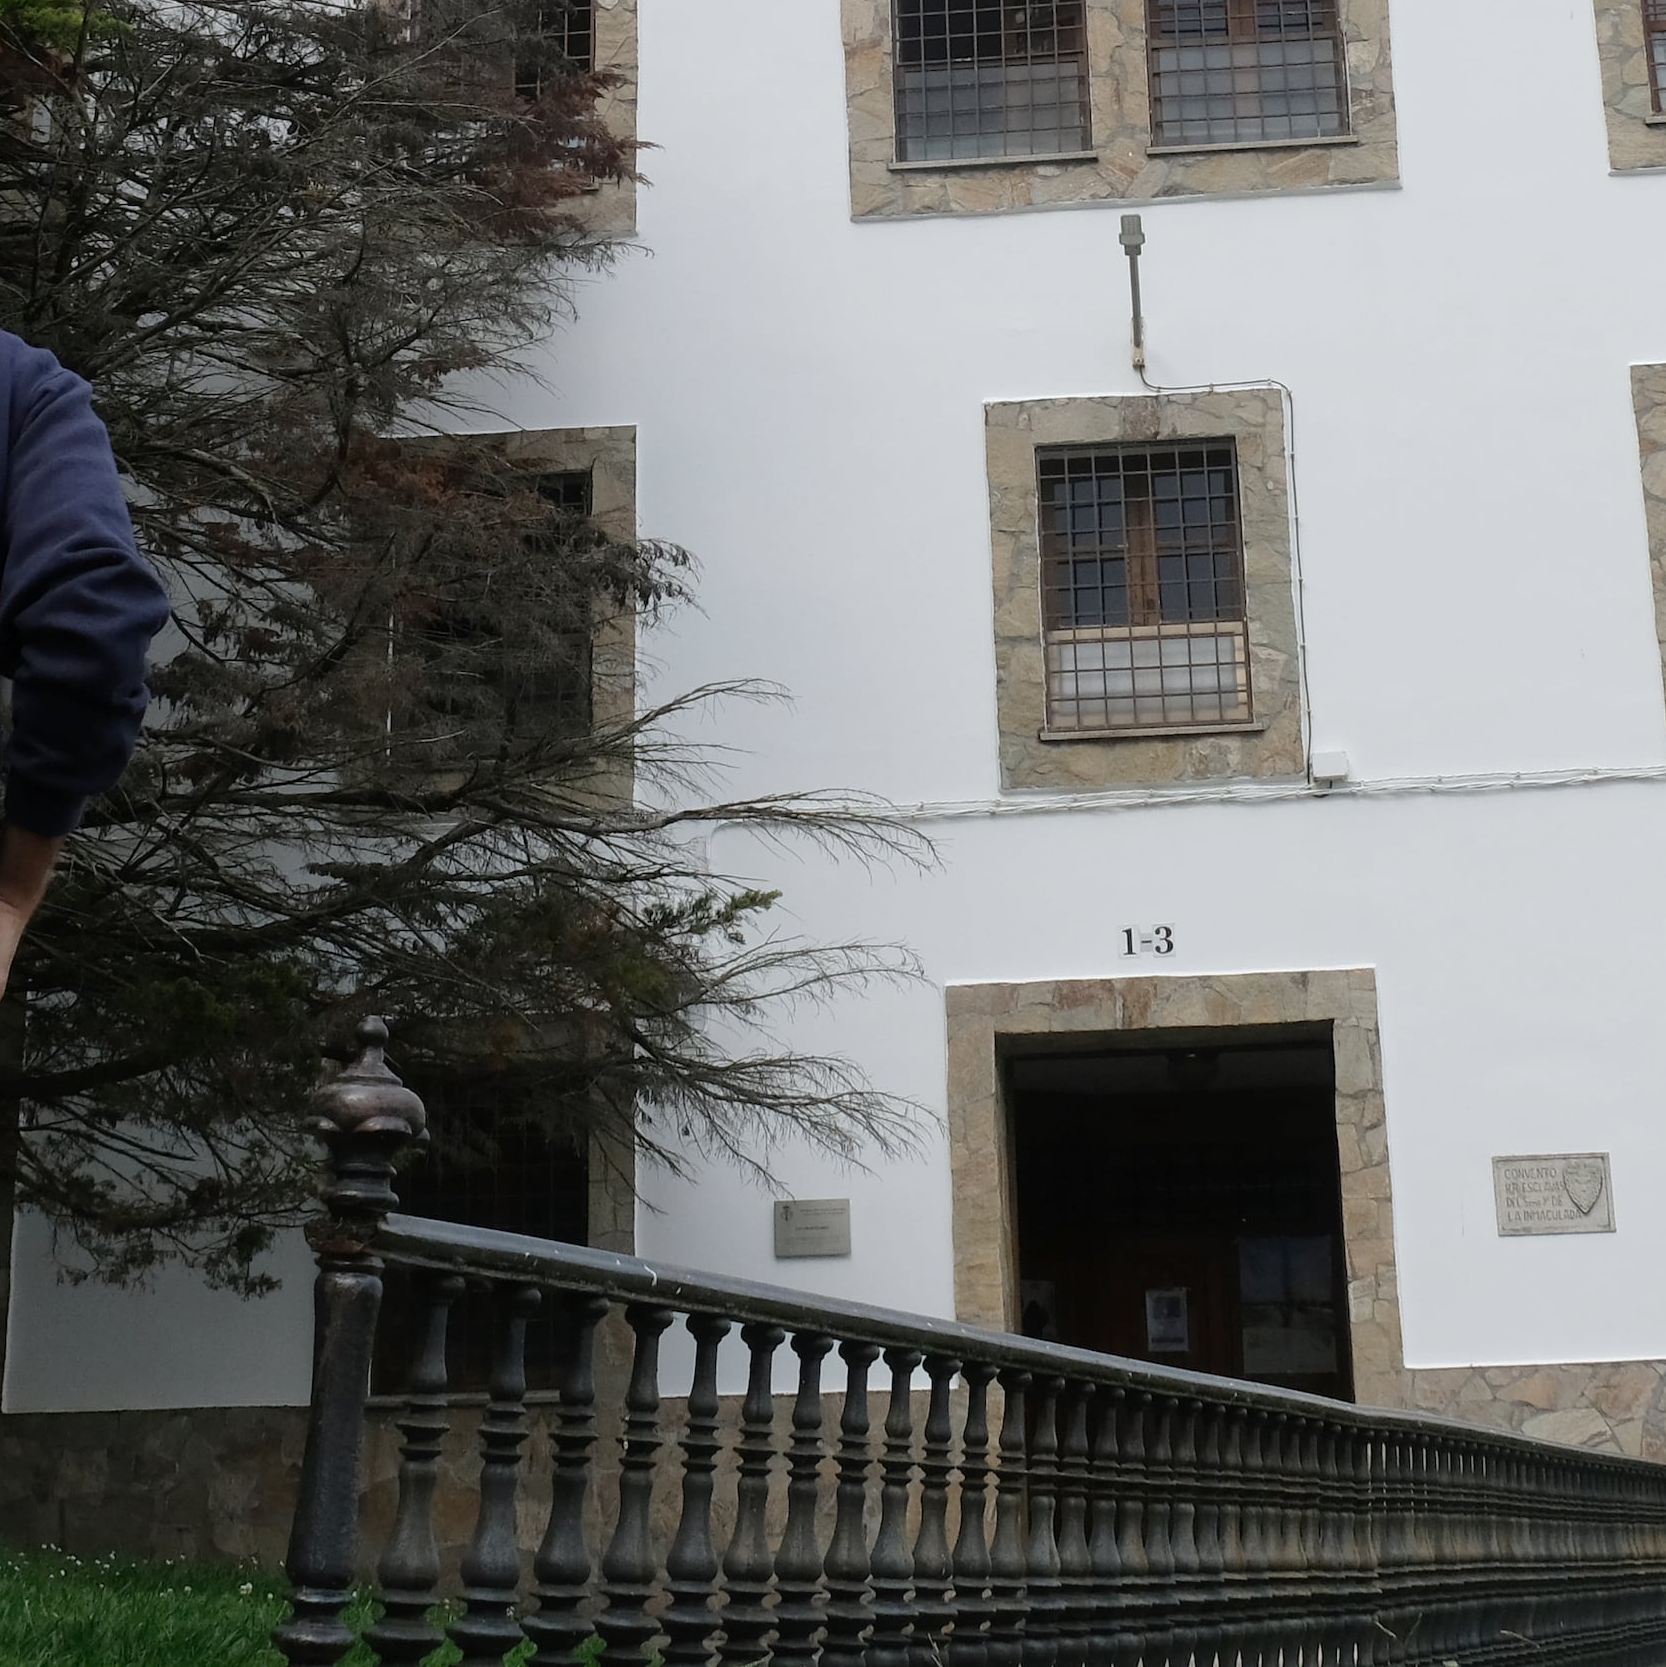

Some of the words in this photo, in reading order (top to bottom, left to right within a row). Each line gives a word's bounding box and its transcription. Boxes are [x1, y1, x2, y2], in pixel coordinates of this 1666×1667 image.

[1122, 925, 1174, 956] 1-3
[1504, 1167, 1557, 1180] CONVENTO
[1521, 1180, 1566, 1193] ESCLAVAS
[1550, 1195, 1563, 1207] DE
[1507, 1210, 1522, 1223] LA
[1523, 1208, 1582, 1222] INMACULADA
